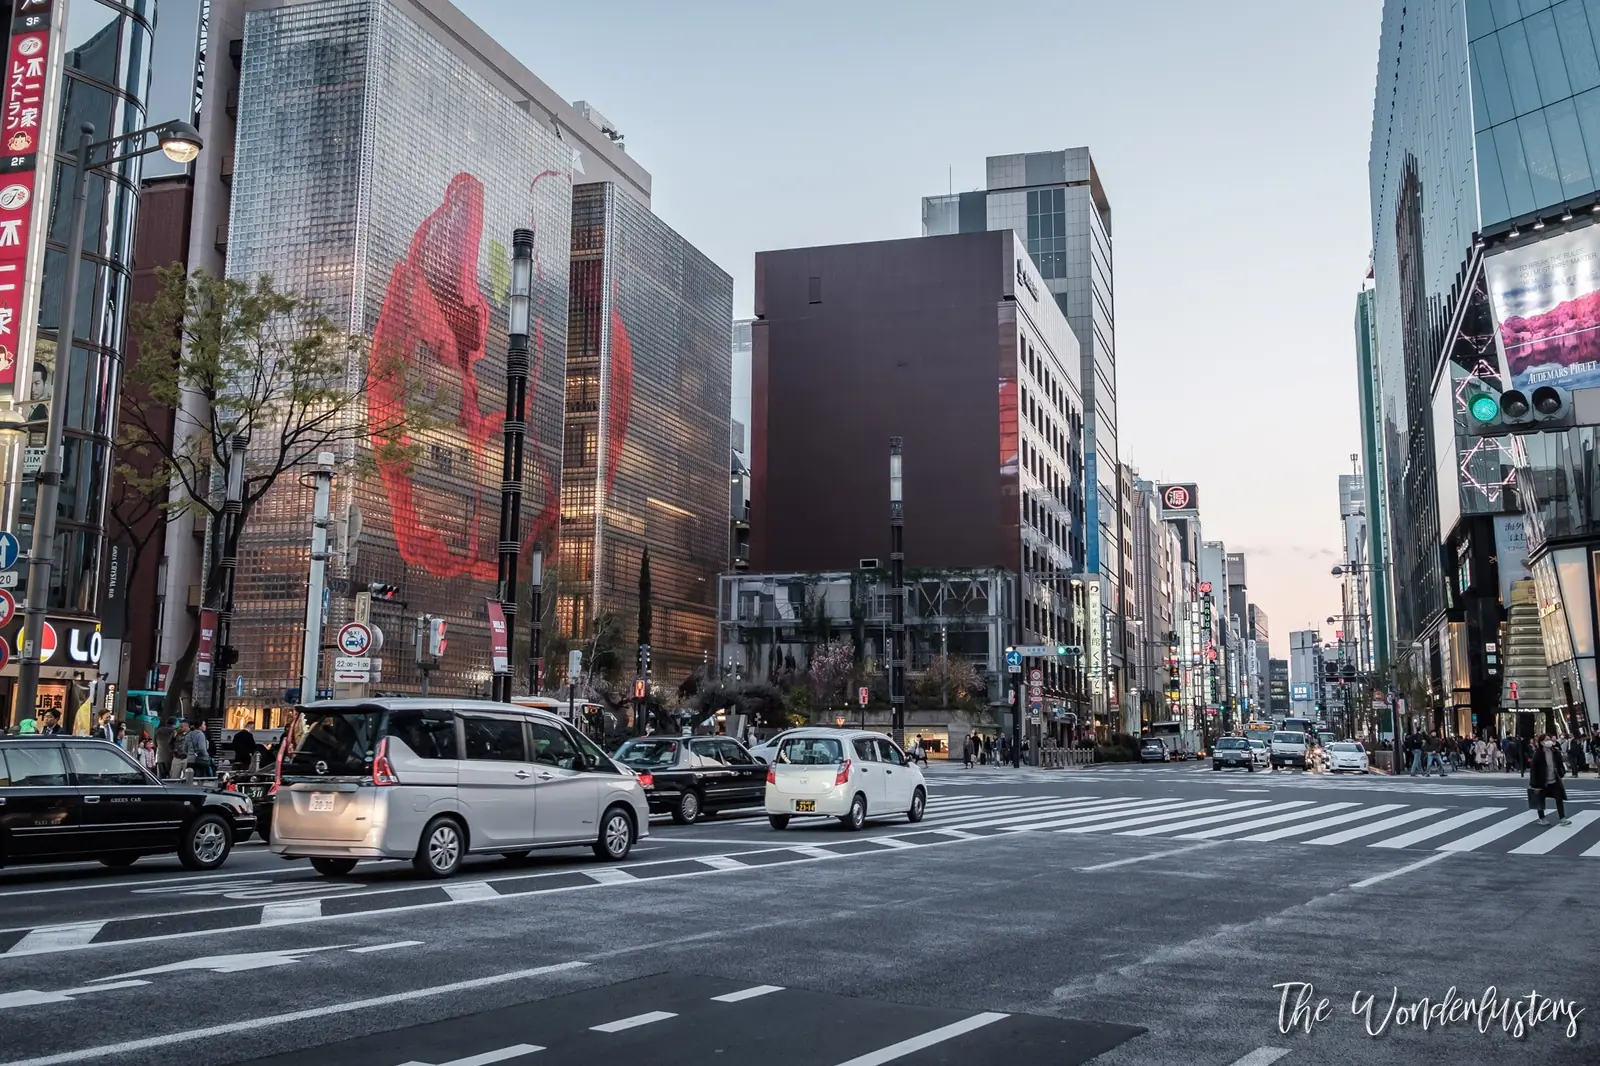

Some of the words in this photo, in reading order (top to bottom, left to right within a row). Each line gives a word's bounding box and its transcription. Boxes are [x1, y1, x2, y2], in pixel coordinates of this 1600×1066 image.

[26, 16, 41, 26] 3F
[6, 60, 25, 130] レストラン
[20, 57, 44, 127] 不二家
[10, 157, 26, 167] 2F
[1528, 258, 1549, 268] BREAK
[1527, 366, 1569, 385] AUDEMARS
[1569, 360, 1597, 376] PIGUET
[1168, 489, 1186, 505] 源
[111, 545, 119, 561] GINZA
[109, 561, 118, 587] CRYSTAL
